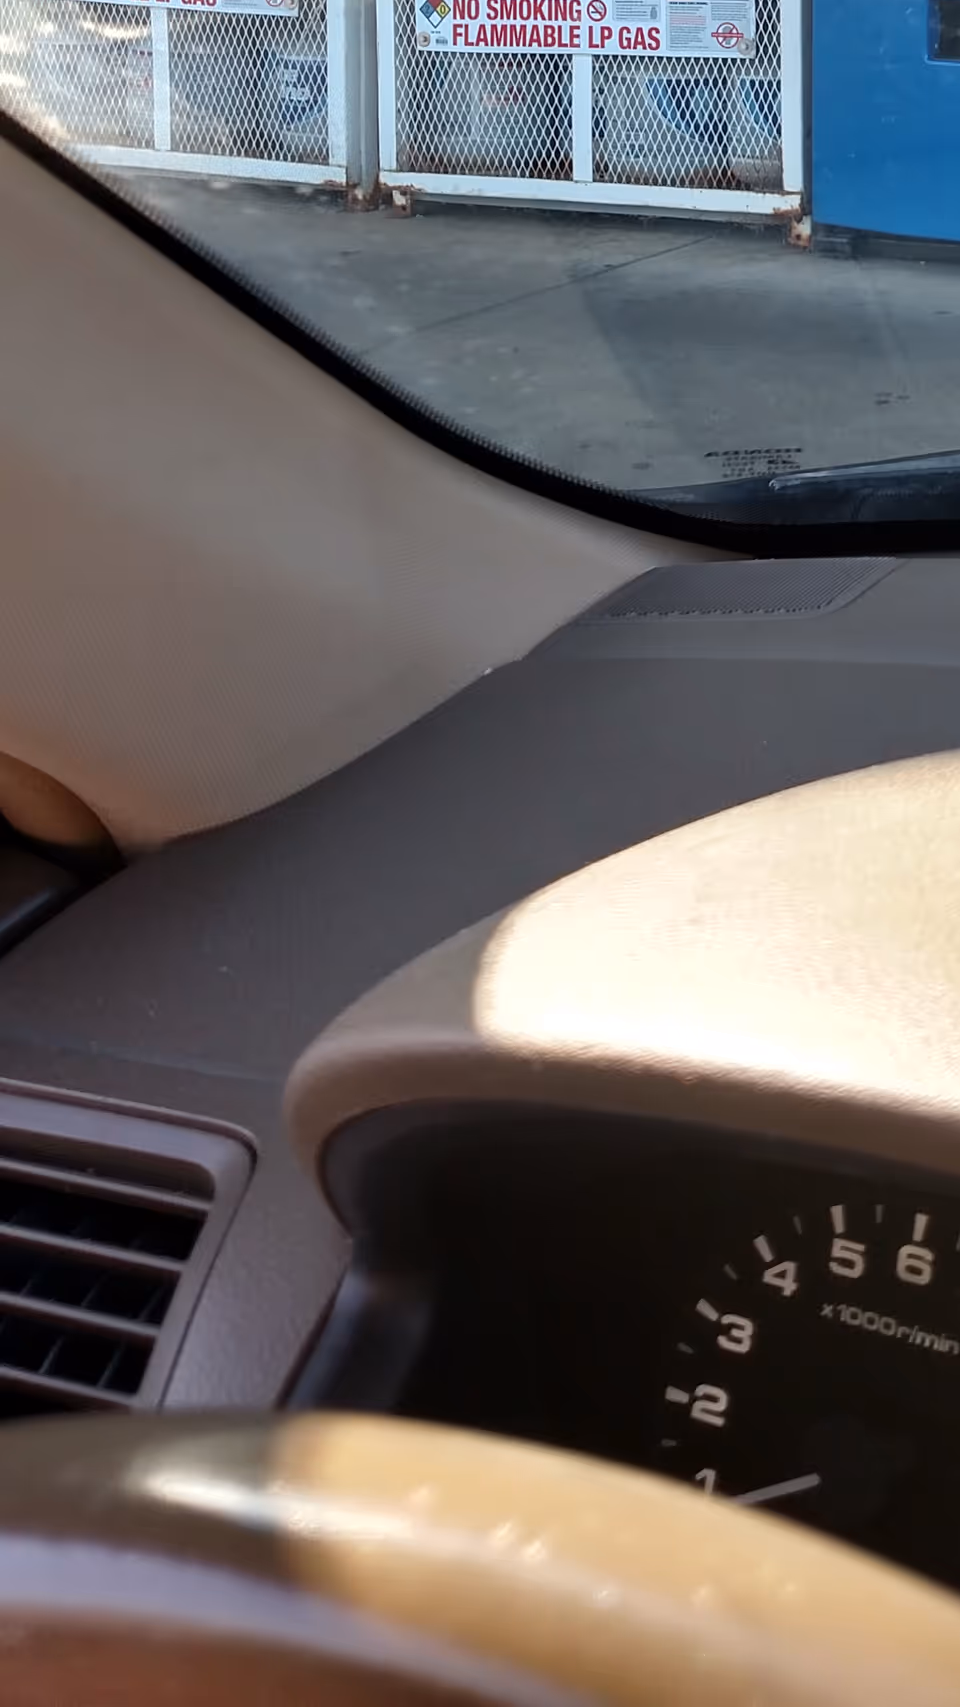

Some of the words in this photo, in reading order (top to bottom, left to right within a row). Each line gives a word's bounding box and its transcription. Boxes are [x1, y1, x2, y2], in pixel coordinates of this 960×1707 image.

[452, 24, 581, 48] FLAMMABLE
[588, 25, 613, 49] LP
[618, 26, 661, 51] GAS
[763, 1260, 798, 1296] 4
[829, 1239, 866, 1279] 5
[896, 1243, 933, 1286] 6
[716, 1314, 753, 1353] 3
[690, 1383, 729, 1427] 2
